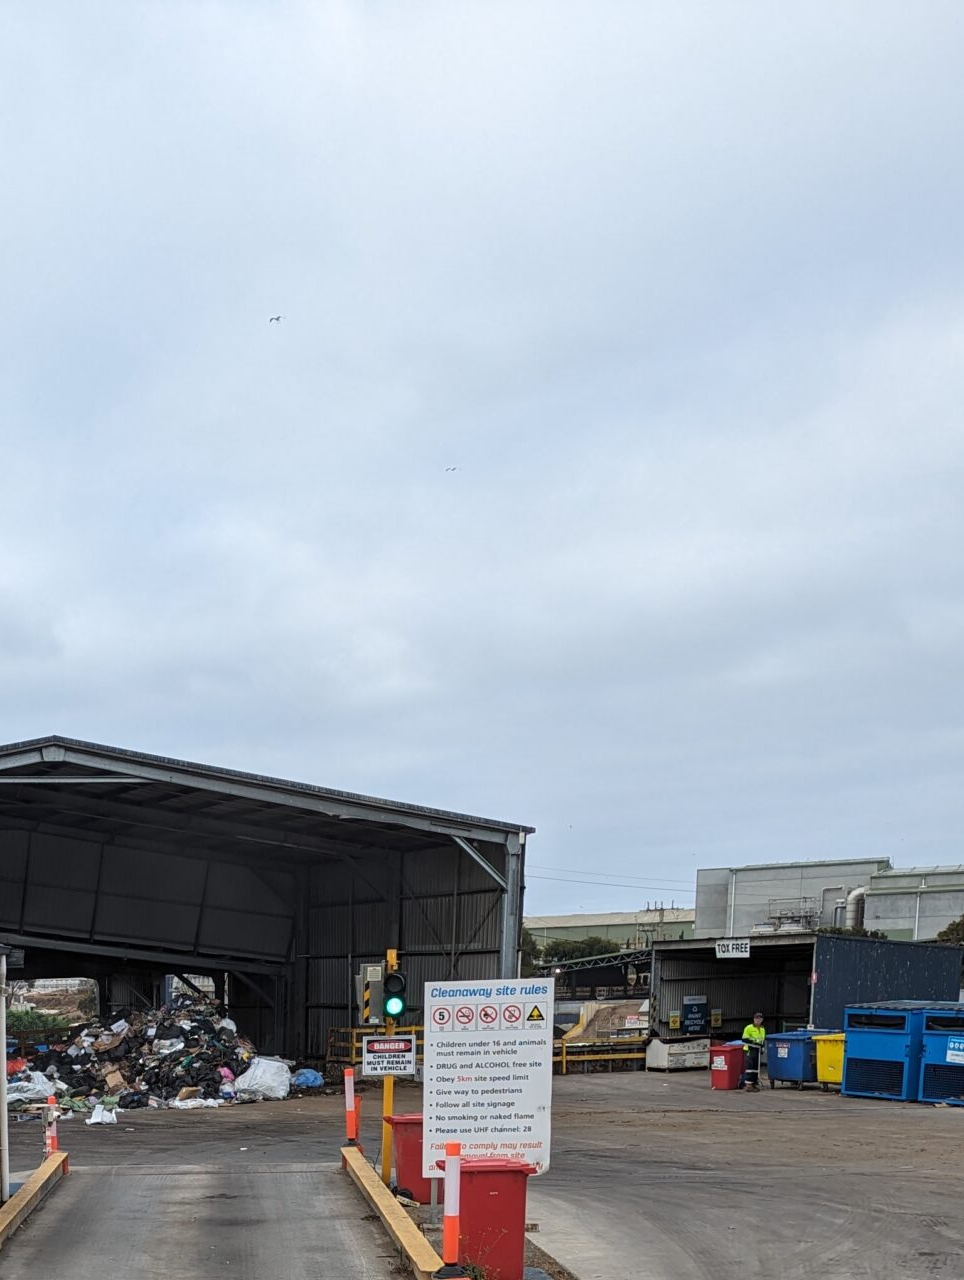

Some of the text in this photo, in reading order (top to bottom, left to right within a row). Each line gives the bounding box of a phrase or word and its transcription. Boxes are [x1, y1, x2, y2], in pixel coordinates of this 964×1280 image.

[717, 943, 748, 953] TOX FREE
[430, 984, 548, 998] Cleanaway site rules
[438, 1011, 445, 1020] 5
[374, 1042, 405, 1050] DANGER
[489, 1075, 511, 1083] speed
[481, 1087, 523, 1096] pedestrians
[486, 1100, 515, 1109] signage
[447, 1114, 477, 1122] smoking
[469, 1142, 498, 1151] comply
[519, 1141, 543, 1149] result
